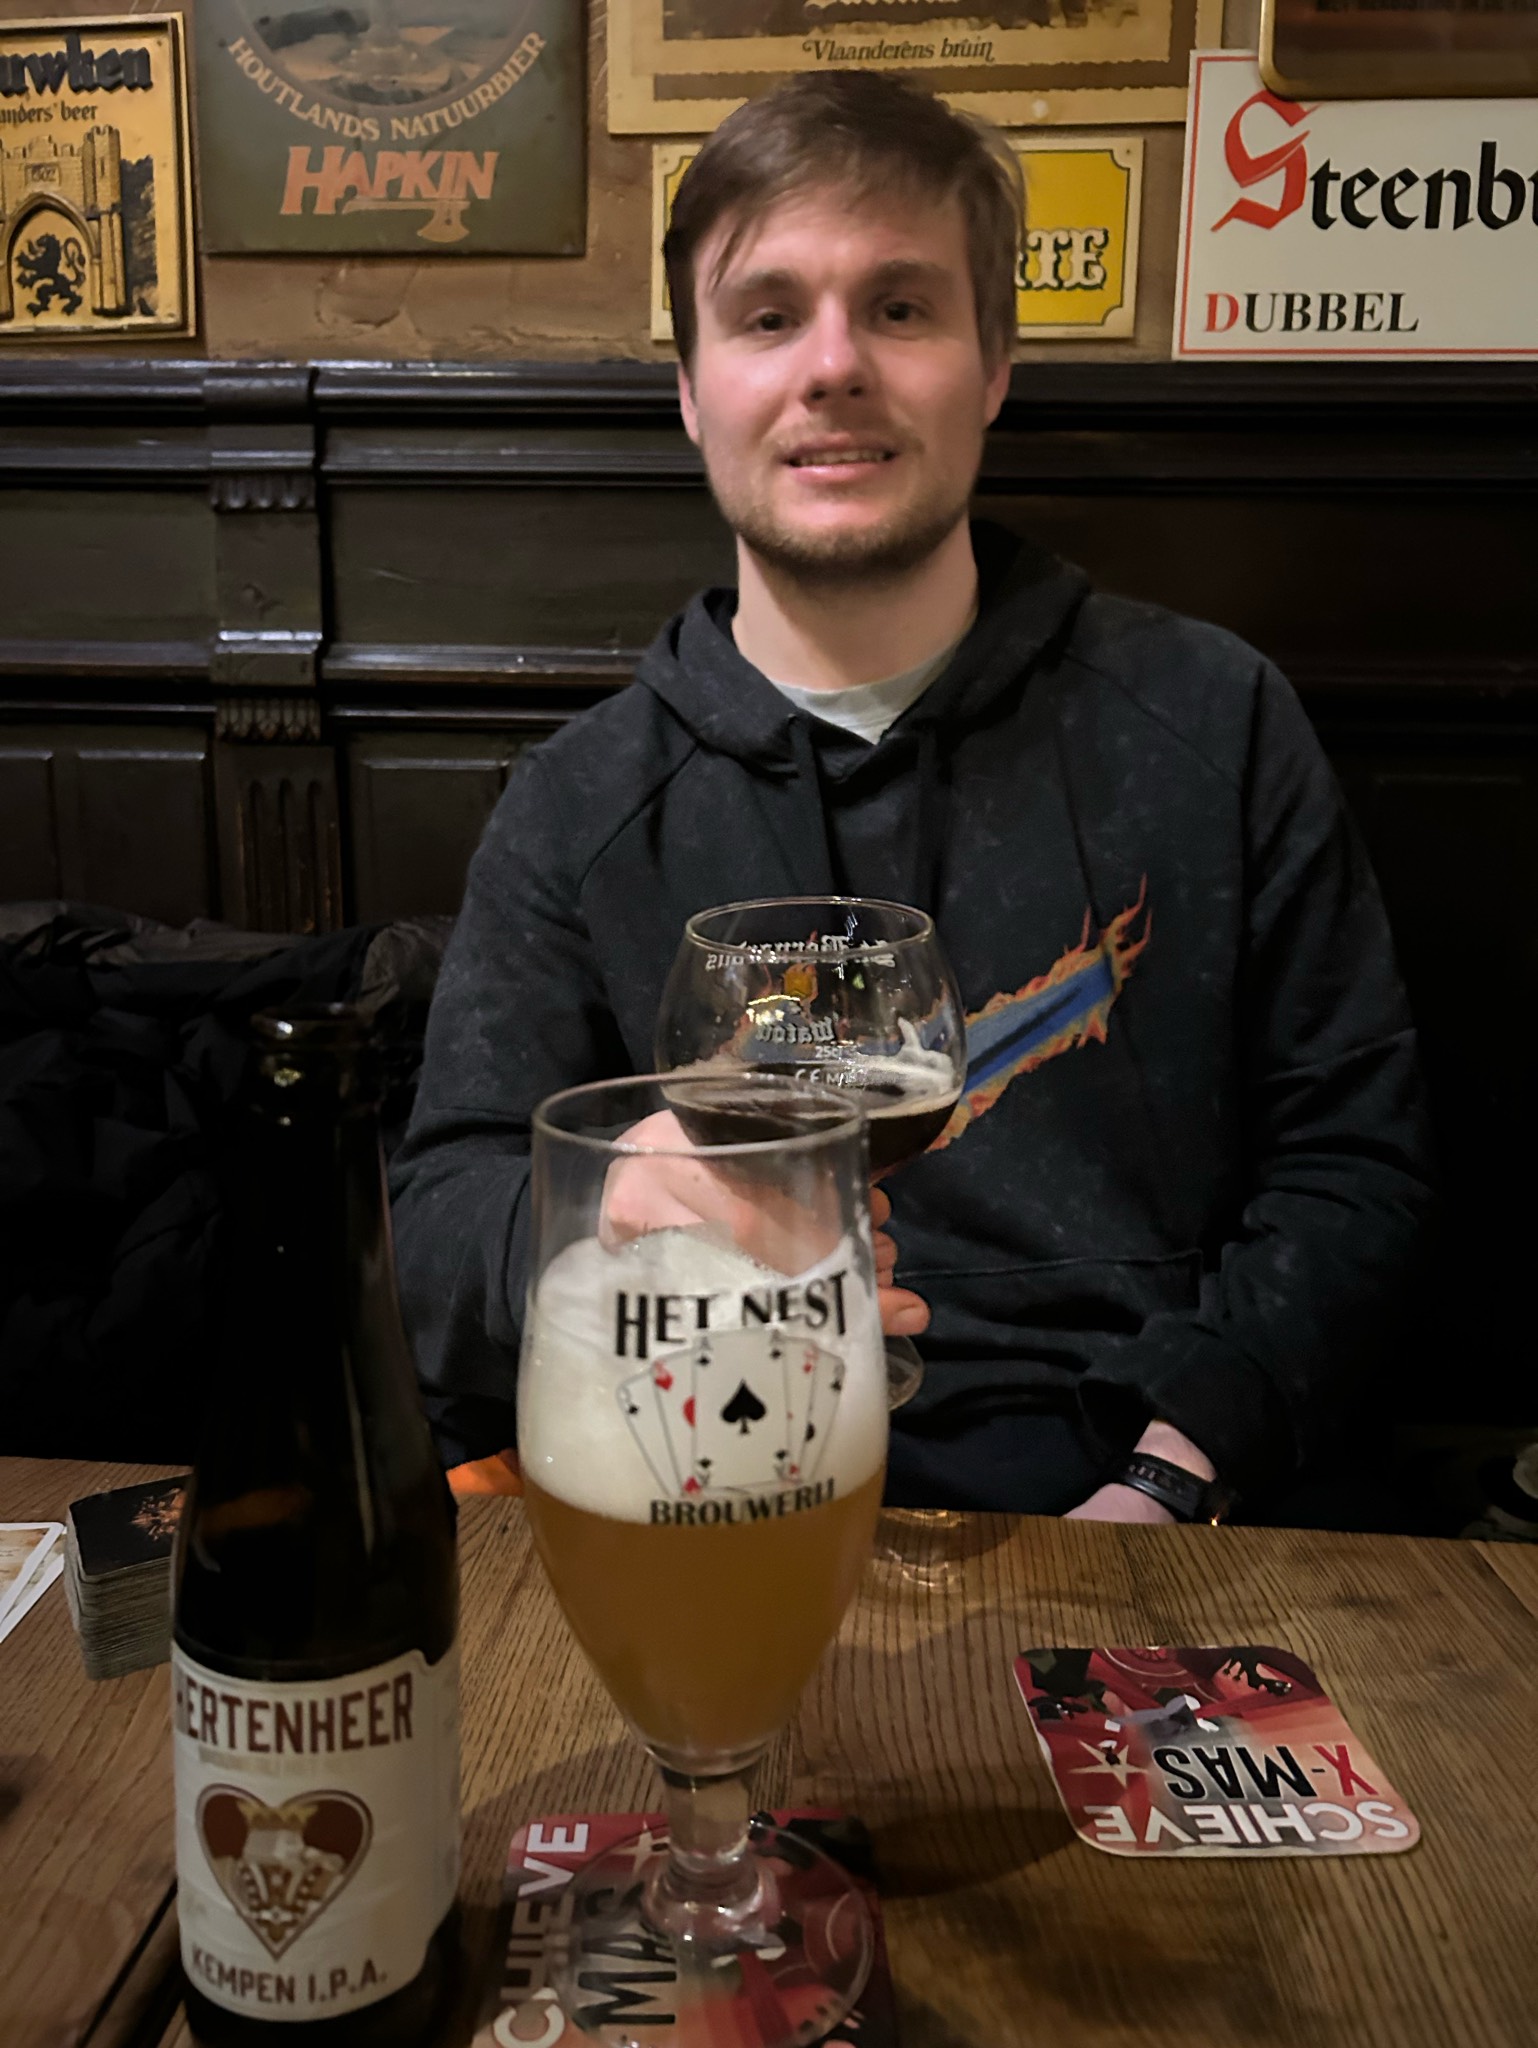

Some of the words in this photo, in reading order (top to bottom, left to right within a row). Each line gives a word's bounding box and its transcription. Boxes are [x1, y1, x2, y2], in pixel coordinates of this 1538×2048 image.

[60, 100, 98, 120] beer
[227, 36, 381, 141] HOUTLANDS
[390, 31, 547, 141] NATUURBIER
[279, 146, 499, 215] HAPKIN
[1204, 292, 1420, 333] DUBBEL
[615, 1290, 718, 1360] HET
[741, 1270, 848, 1336] NEST
[177, 1672, 414, 1754] ERTENHEER
[1152, 1744, 1379, 1800] X-MAS
[1083, 1801, 1410, 1844] SCHIEVE
[191, 1943, 295, 2004] KEMPEN
[308, 1957, 388, 2002] I.P.A.
